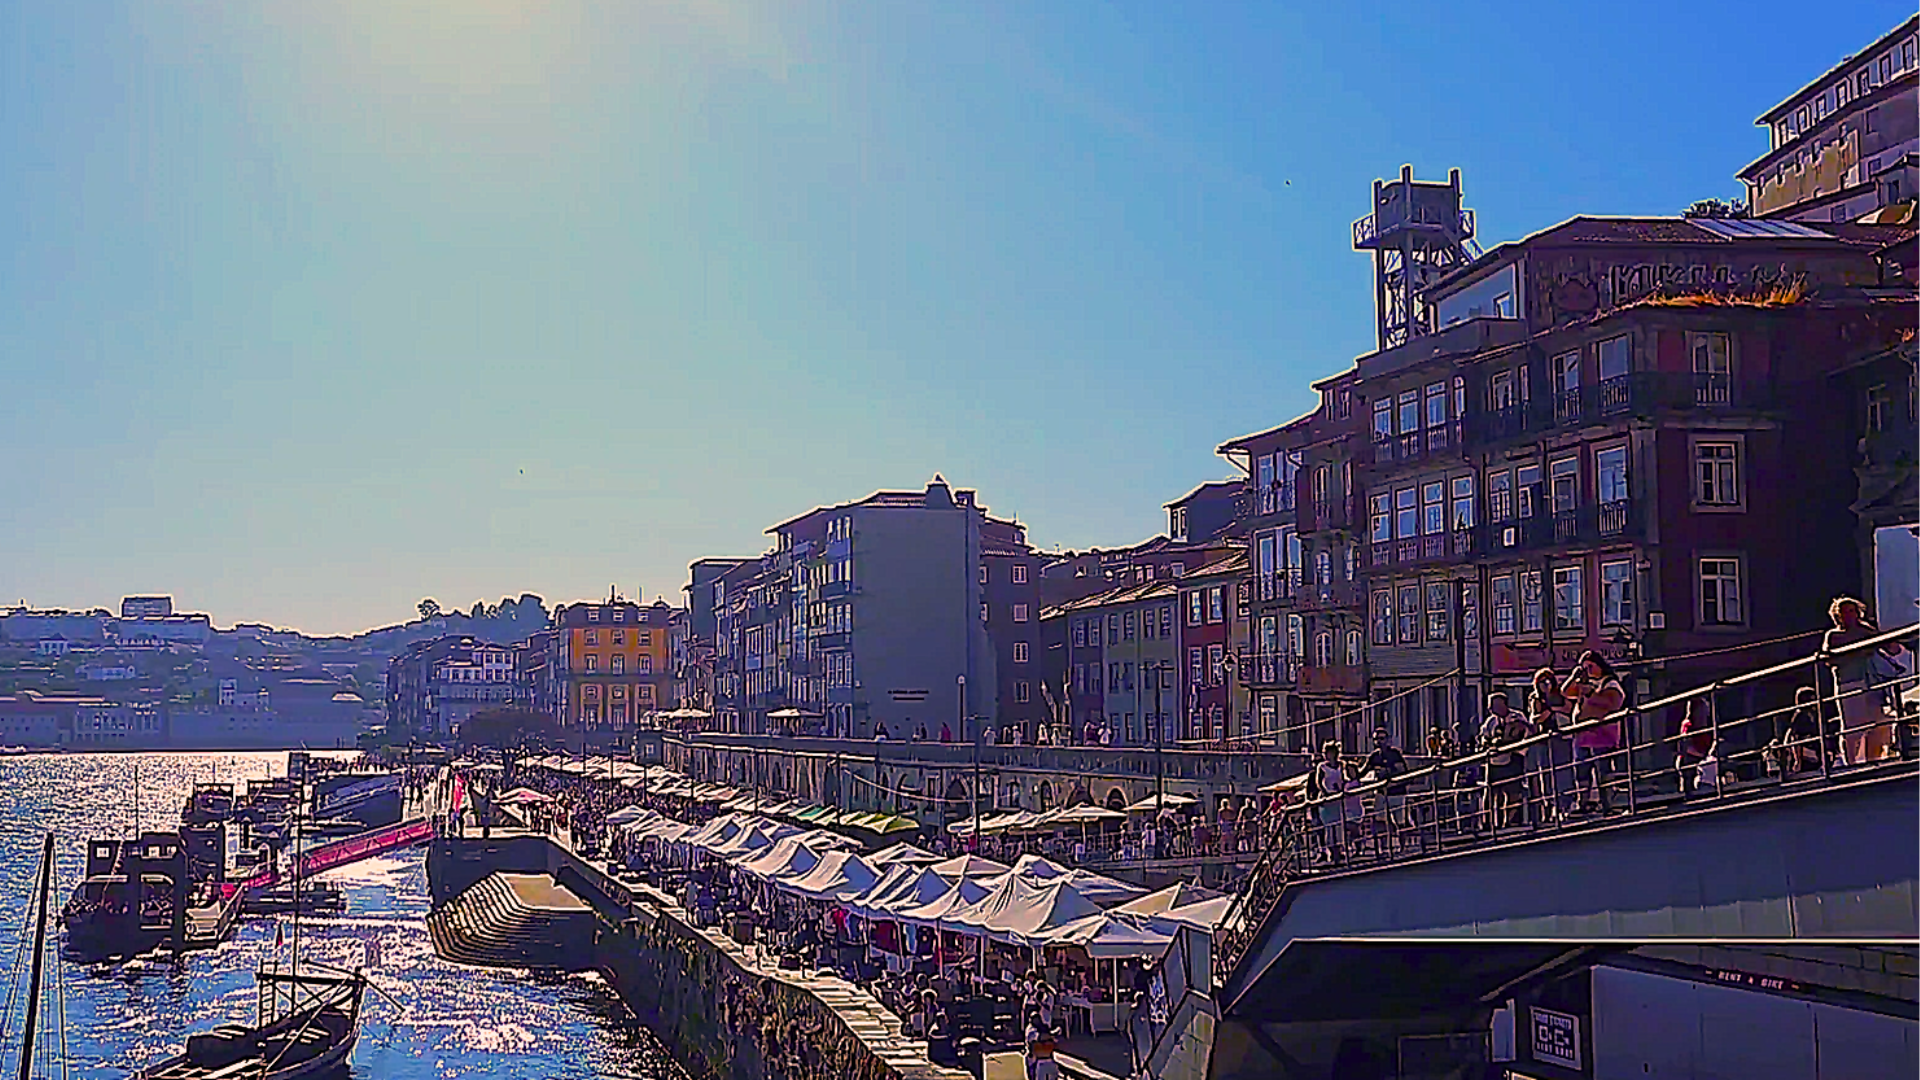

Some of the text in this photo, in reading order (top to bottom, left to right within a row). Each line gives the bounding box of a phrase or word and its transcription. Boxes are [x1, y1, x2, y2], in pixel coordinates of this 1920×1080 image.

[1718, 970, 1785, 990] RENT A BIKE
